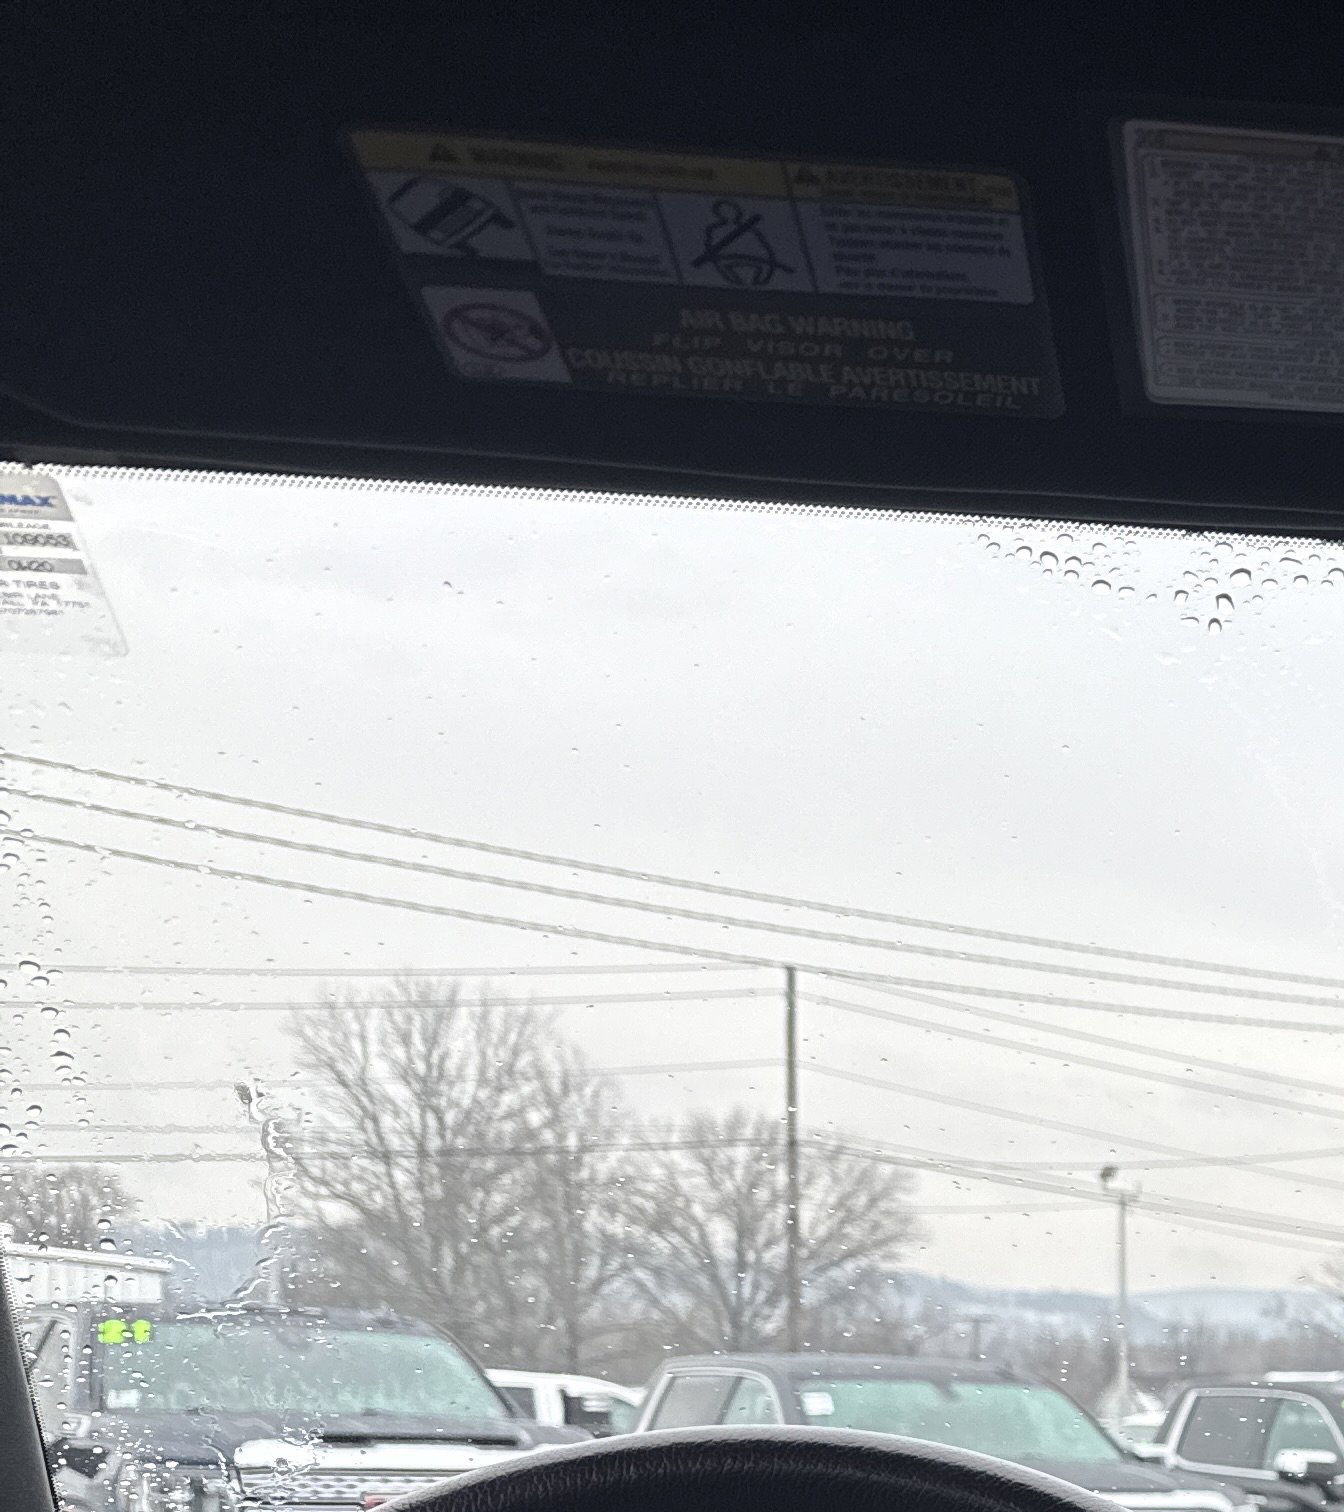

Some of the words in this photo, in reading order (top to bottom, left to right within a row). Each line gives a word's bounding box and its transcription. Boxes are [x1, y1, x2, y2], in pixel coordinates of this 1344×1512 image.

[680, 309, 724, 331] AIR
[727, 312, 785, 335] BAG
[785, 315, 915, 341] WARNING
[652, 332, 721, 349] FLIP
[746, 338, 843, 358] VISOR
[866, 345, 954, 364] OVER
[565, 347, 682, 373] COUSSIN
[684, 356, 837, 384] GONFLABLE
[841, 366, 1041, 397] AVERTISSEMENT
[607, 371, 743, 392] REPLIER
[768, 382, 804, 397] LE
[829, 384, 1021, 410] PARESOLEIL
